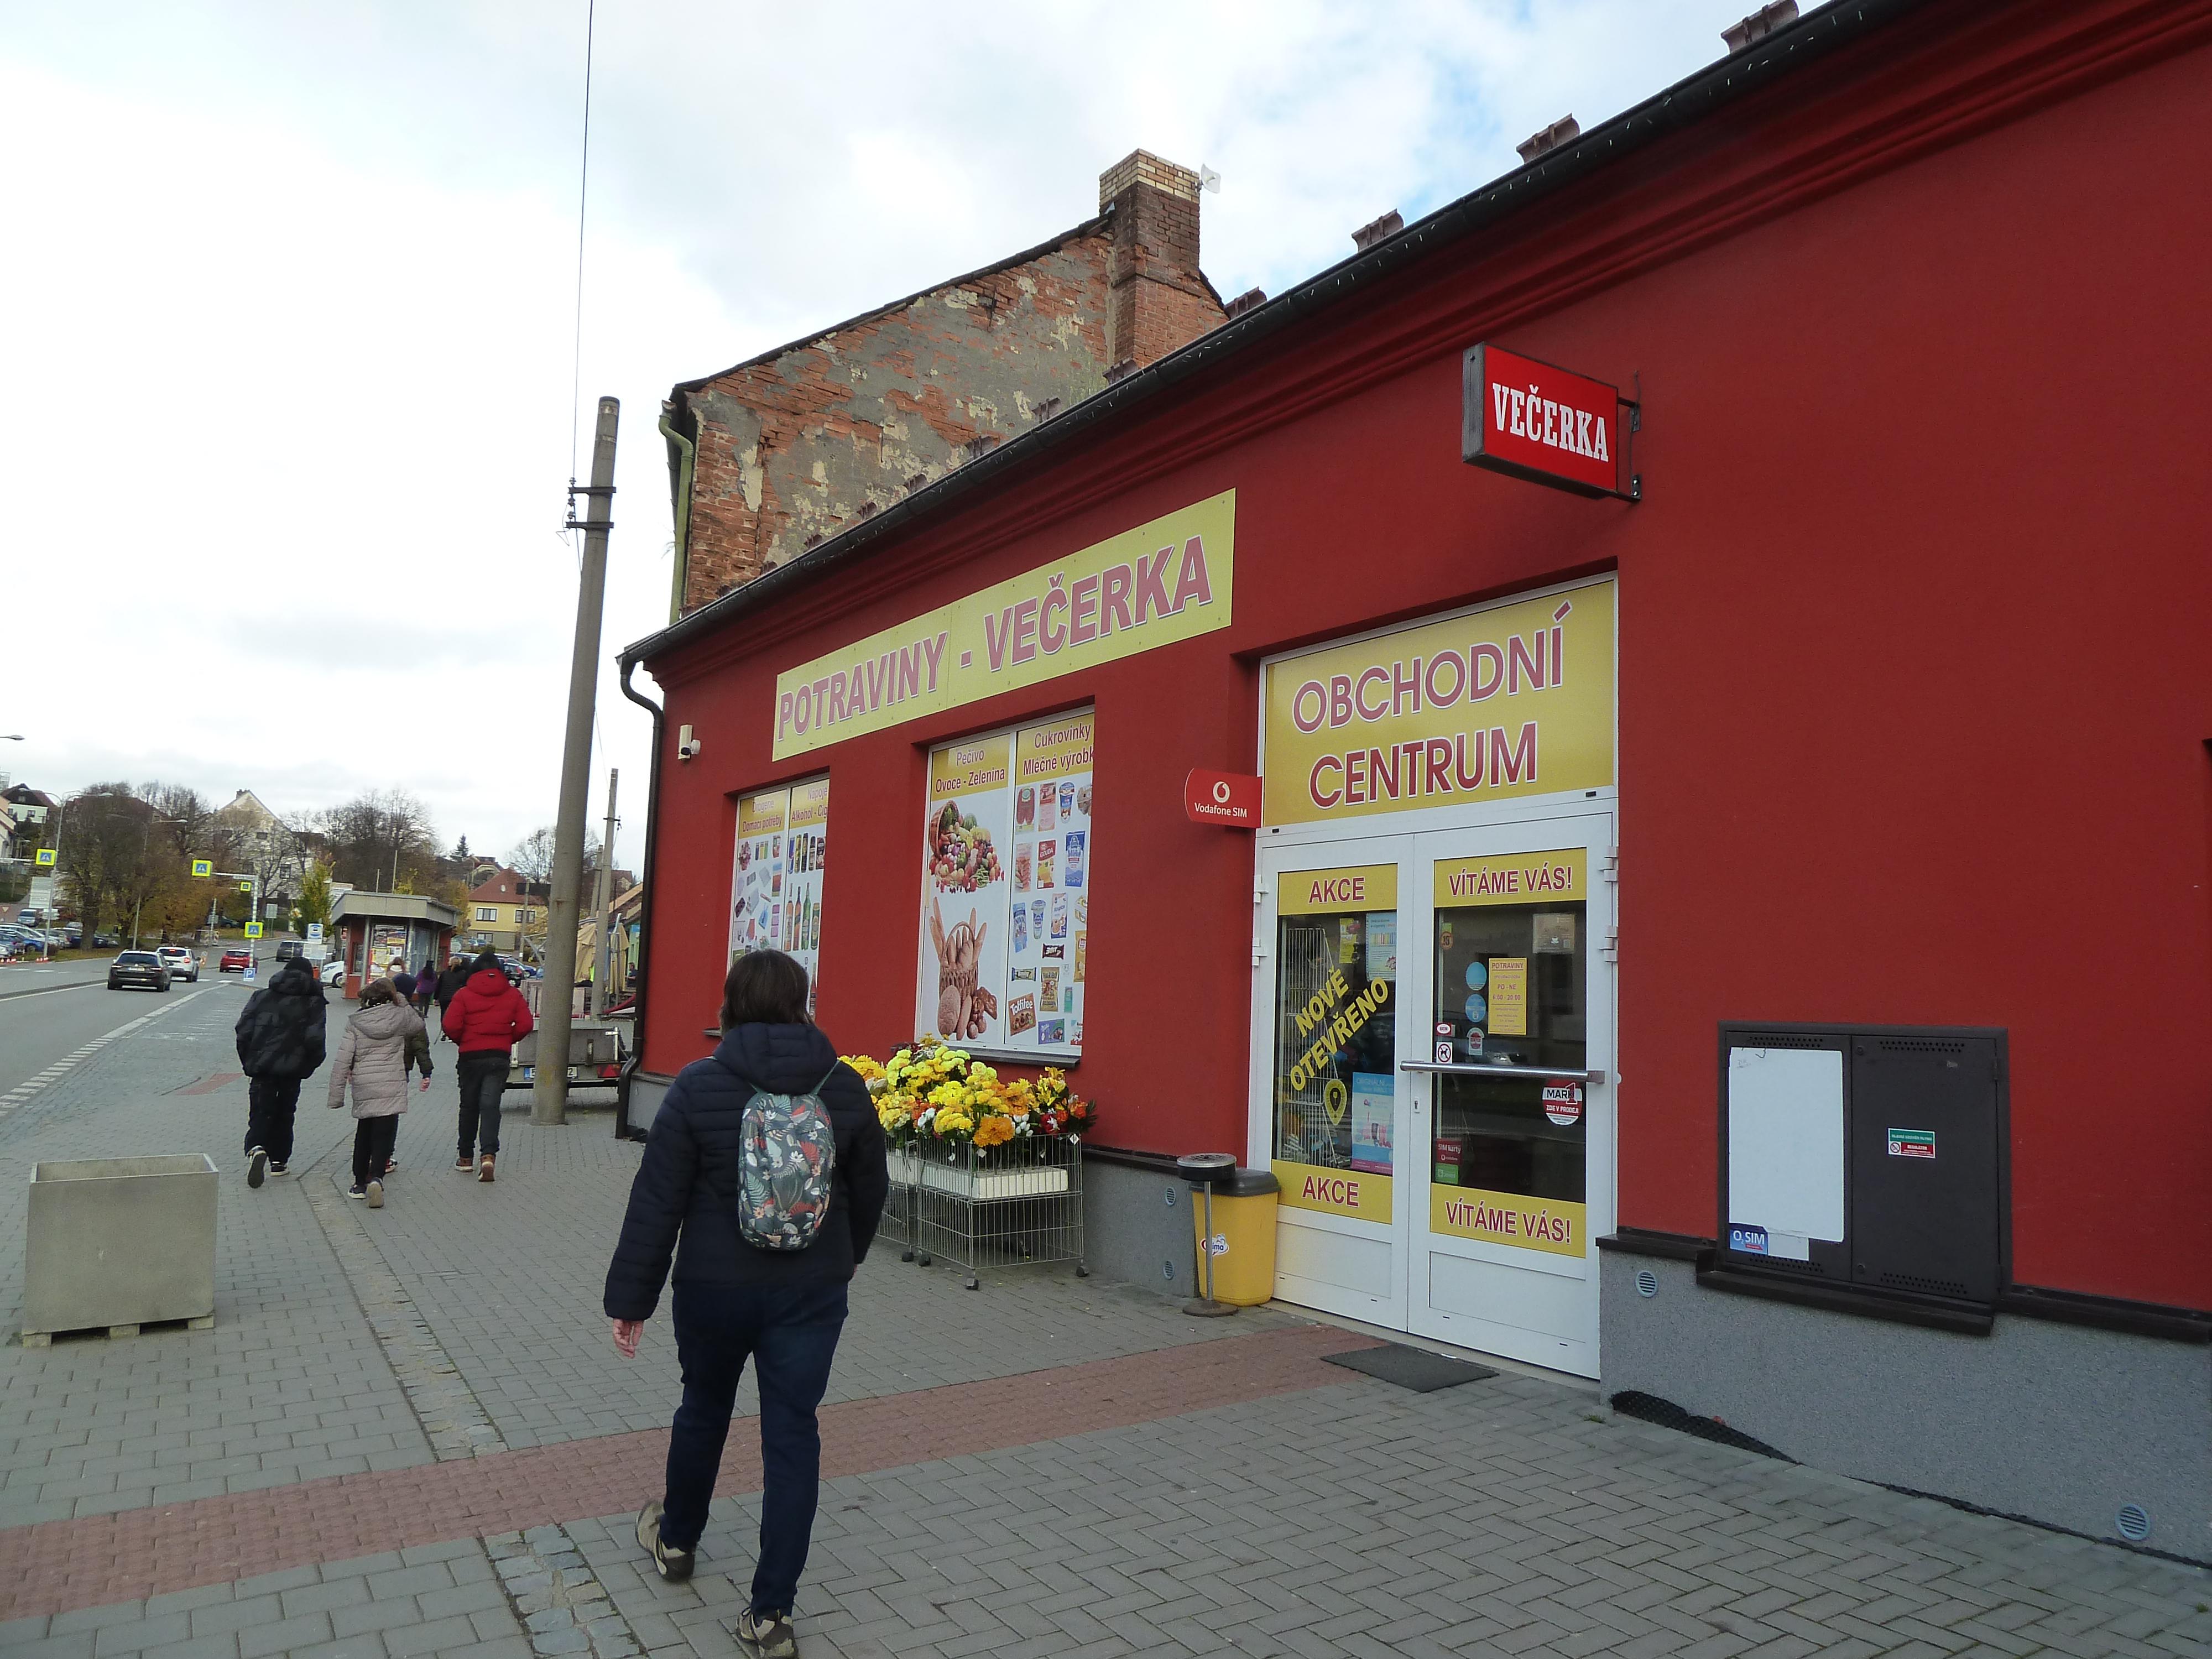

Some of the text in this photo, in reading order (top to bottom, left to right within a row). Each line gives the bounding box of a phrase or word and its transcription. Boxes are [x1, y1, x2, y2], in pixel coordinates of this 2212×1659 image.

[1493, 382, 1609, 462] VEČERKA
[777, 630, 948, 742] POTRAVINY
[984, 534, 1213, 673] VEČERKA
[1292, 599, 1572, 734] OBCHODNÍ
[1035, 723, 1091, 748] Cukrovinky
[957, 749, 984, 766] Pečivo
[1023, 755, 1057, 775] Mléčné
[1309, 720, 1537, 810] CENTRUM
[936, 777, 961, 792] Ovoce
[968, 767, 1005, 786] Zelenina
[791, 807, 813, 822] Alkohol
[1194, 802, 1248, 818] Vodafone SIM
[1308, 877, 1365, 904] AKCE
[1448, 862, 1572, 896] VÍTÁME VÁS!
[1295, 965, 1349, 1037] NOVĚ
[1290, 977, 1388, 1091] OTEVŘENO
[1301, 1175, 1360, 1207] AKCE
[1445, 1197, 1571, 1244] VÍTÁME VÁS!
[1745, 1232, 1765, 1245] SIM
